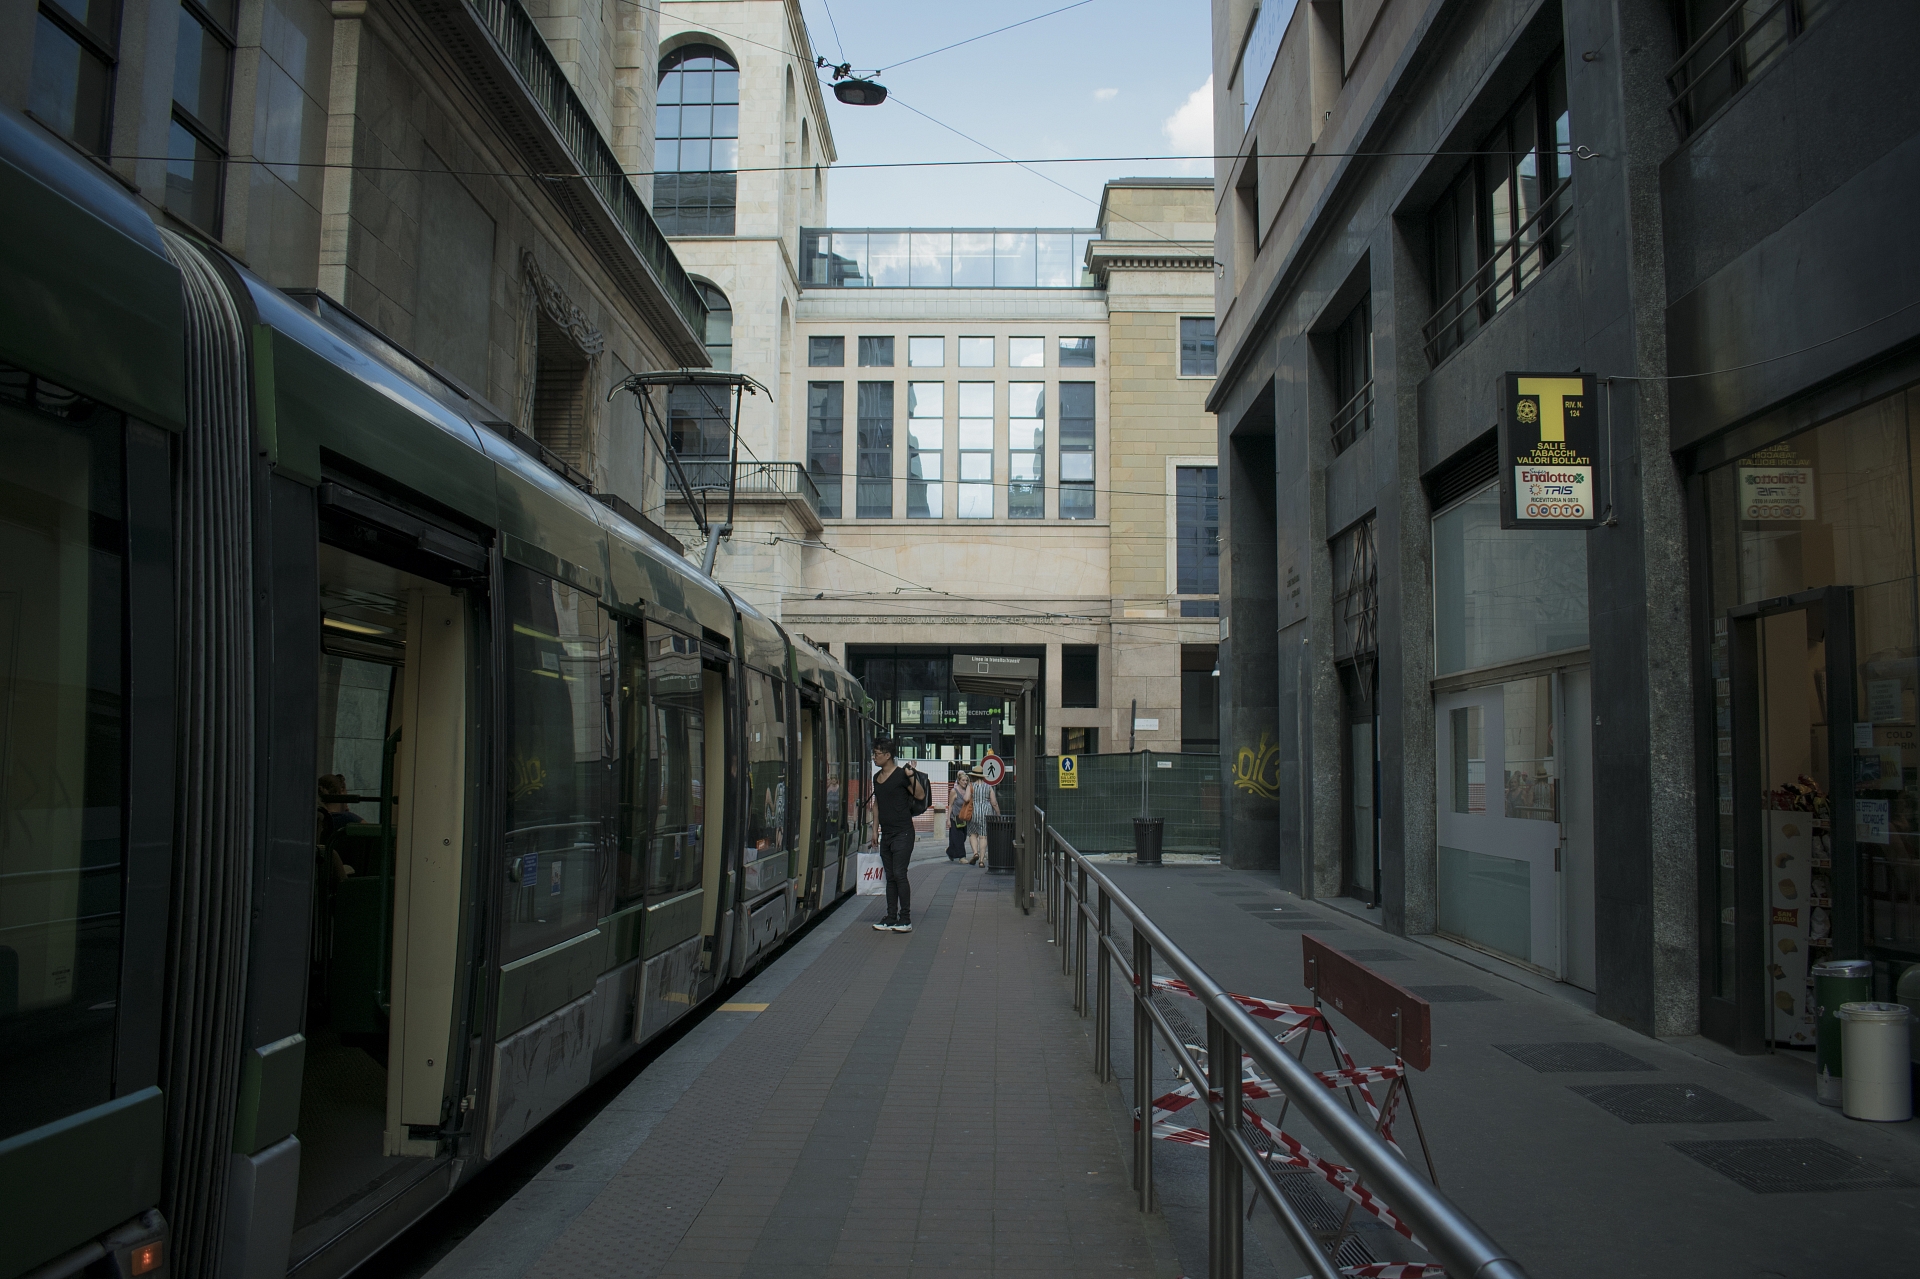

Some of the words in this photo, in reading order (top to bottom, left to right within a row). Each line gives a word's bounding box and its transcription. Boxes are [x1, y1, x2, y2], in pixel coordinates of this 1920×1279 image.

[1517, 377, 1584, 442] T
[1537, 442, 1559, 450] SALI
[1560, 442, 1566, 450] E
[1551, 457, 1590, 465] BOLLATI
[1522, 471, 1576, 483] Enalotto
[1544, 486, 1573, 495] TRIS
[1886, 731, 1913, 739] COLD
[1777, 910, 1792, 918] SAN
[1773, 916, 1796, 924] CARLO
